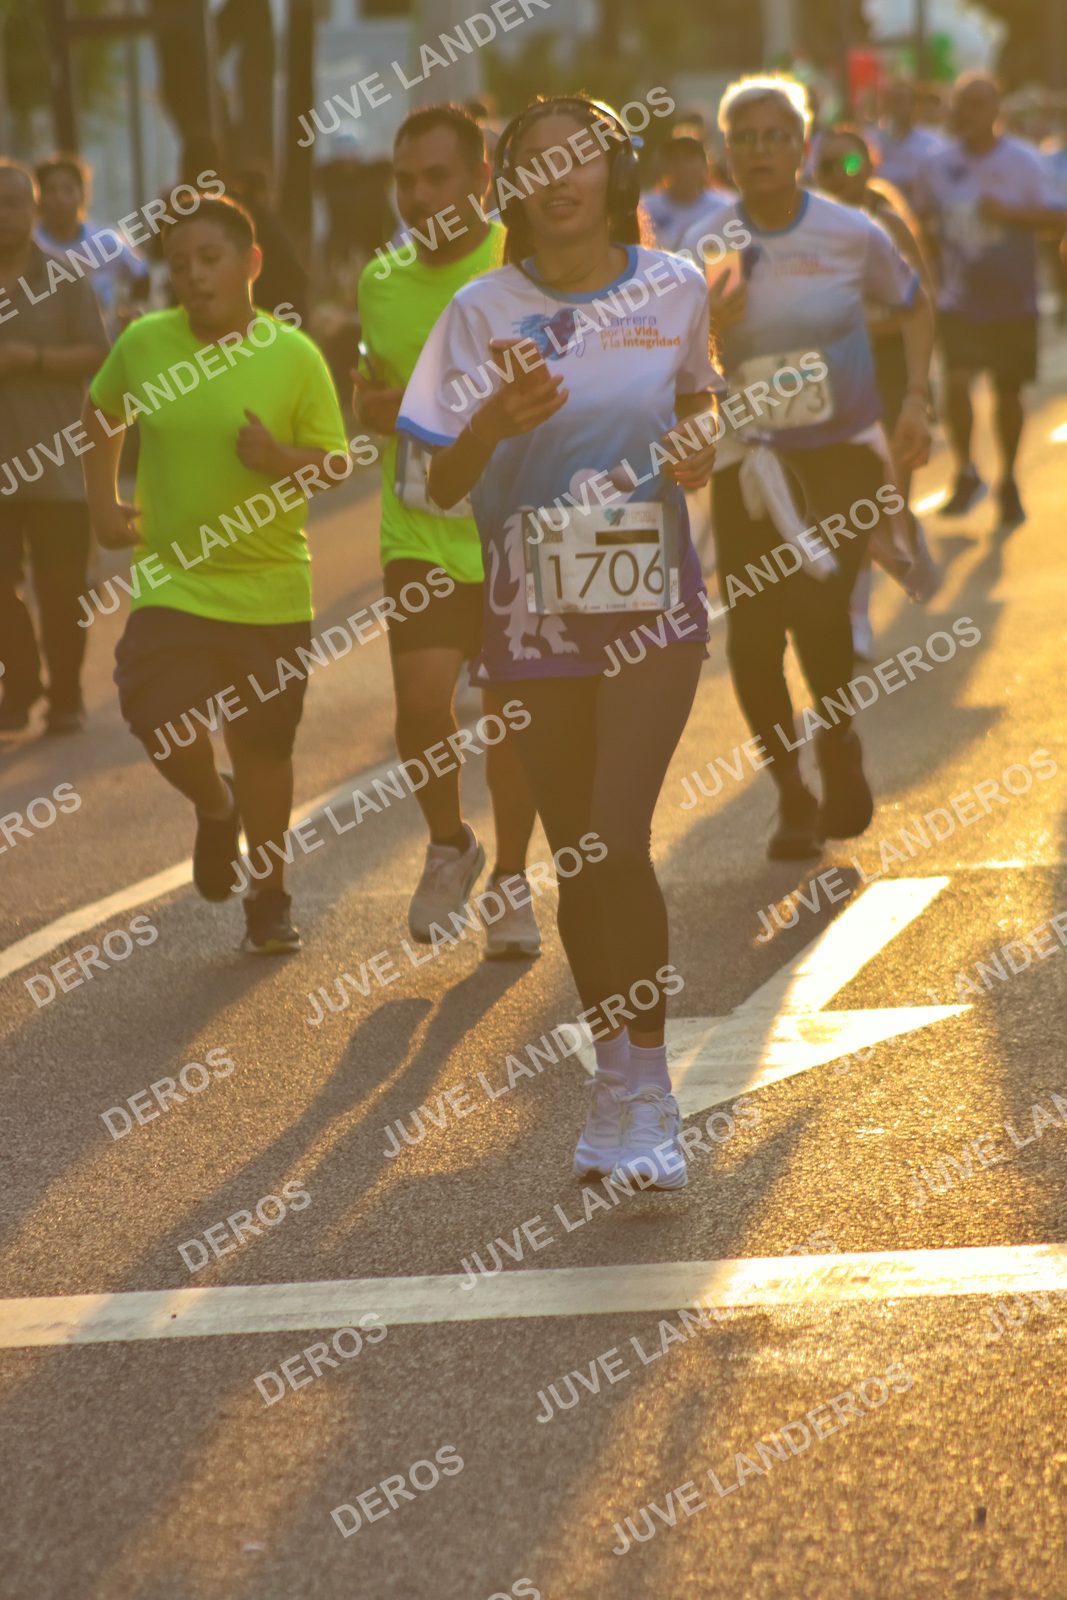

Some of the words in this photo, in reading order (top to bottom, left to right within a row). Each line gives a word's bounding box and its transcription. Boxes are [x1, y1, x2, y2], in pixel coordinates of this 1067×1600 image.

[634, 326, 658, 337] Vida
[623, 335, 681, 350] Integridad
[548, 549, 664, 599] 1706
